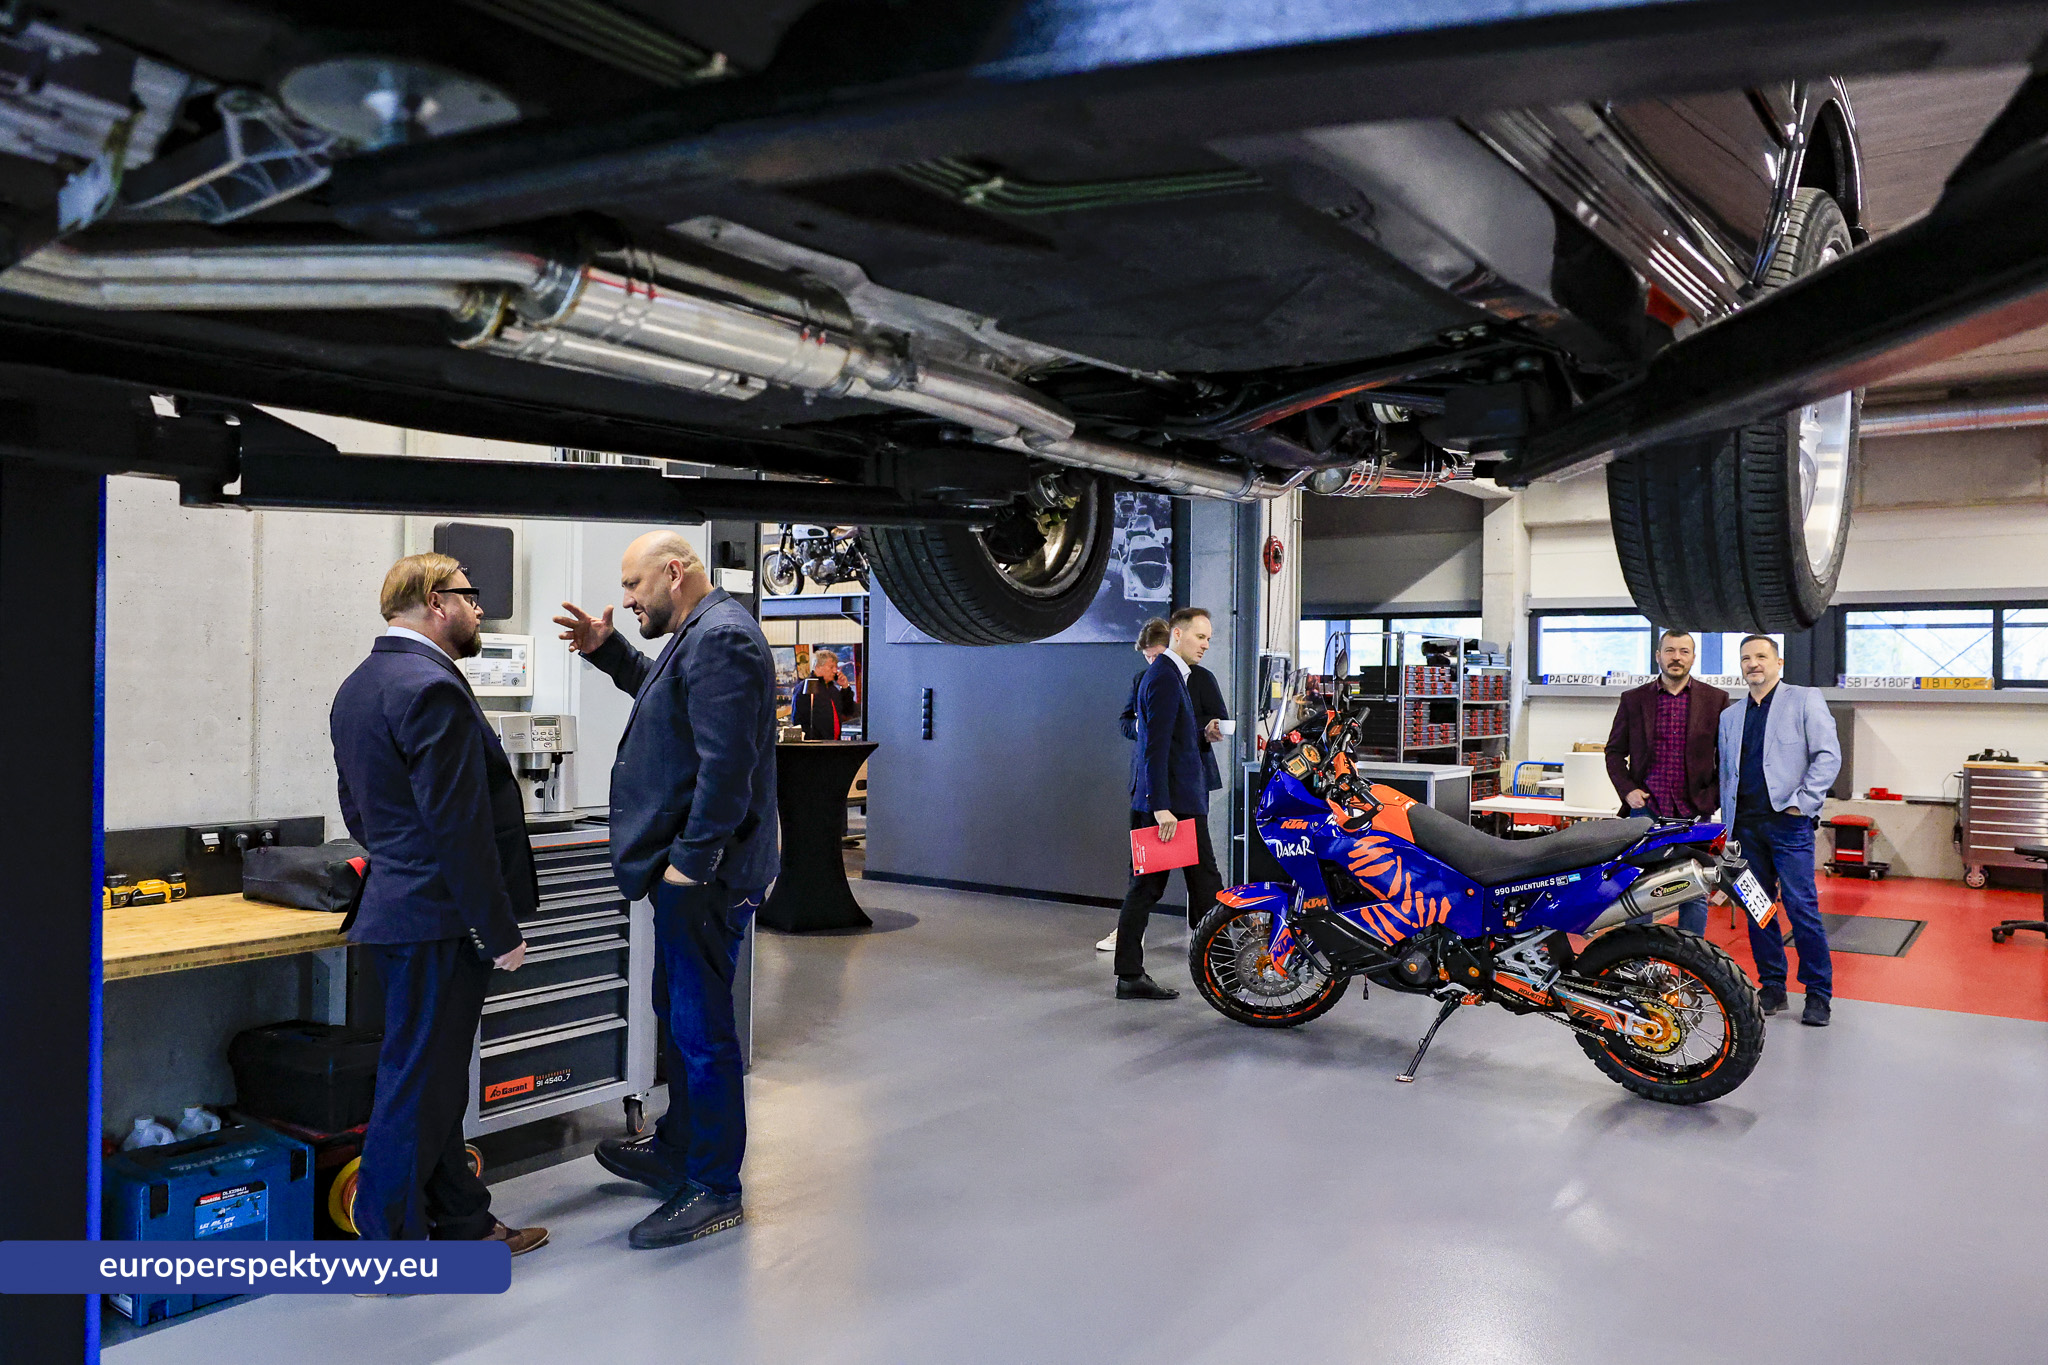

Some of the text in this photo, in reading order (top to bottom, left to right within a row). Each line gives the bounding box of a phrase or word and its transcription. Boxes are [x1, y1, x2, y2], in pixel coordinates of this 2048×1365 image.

[1280, 819, 1309, 830] KTM
[1264, 835, 1315, 859] DAKAR
[1494, 886, 1511, 896] 990
[1303, 897, 1328, 909] KTM
[501, 1083, 528, 1096] Garant
